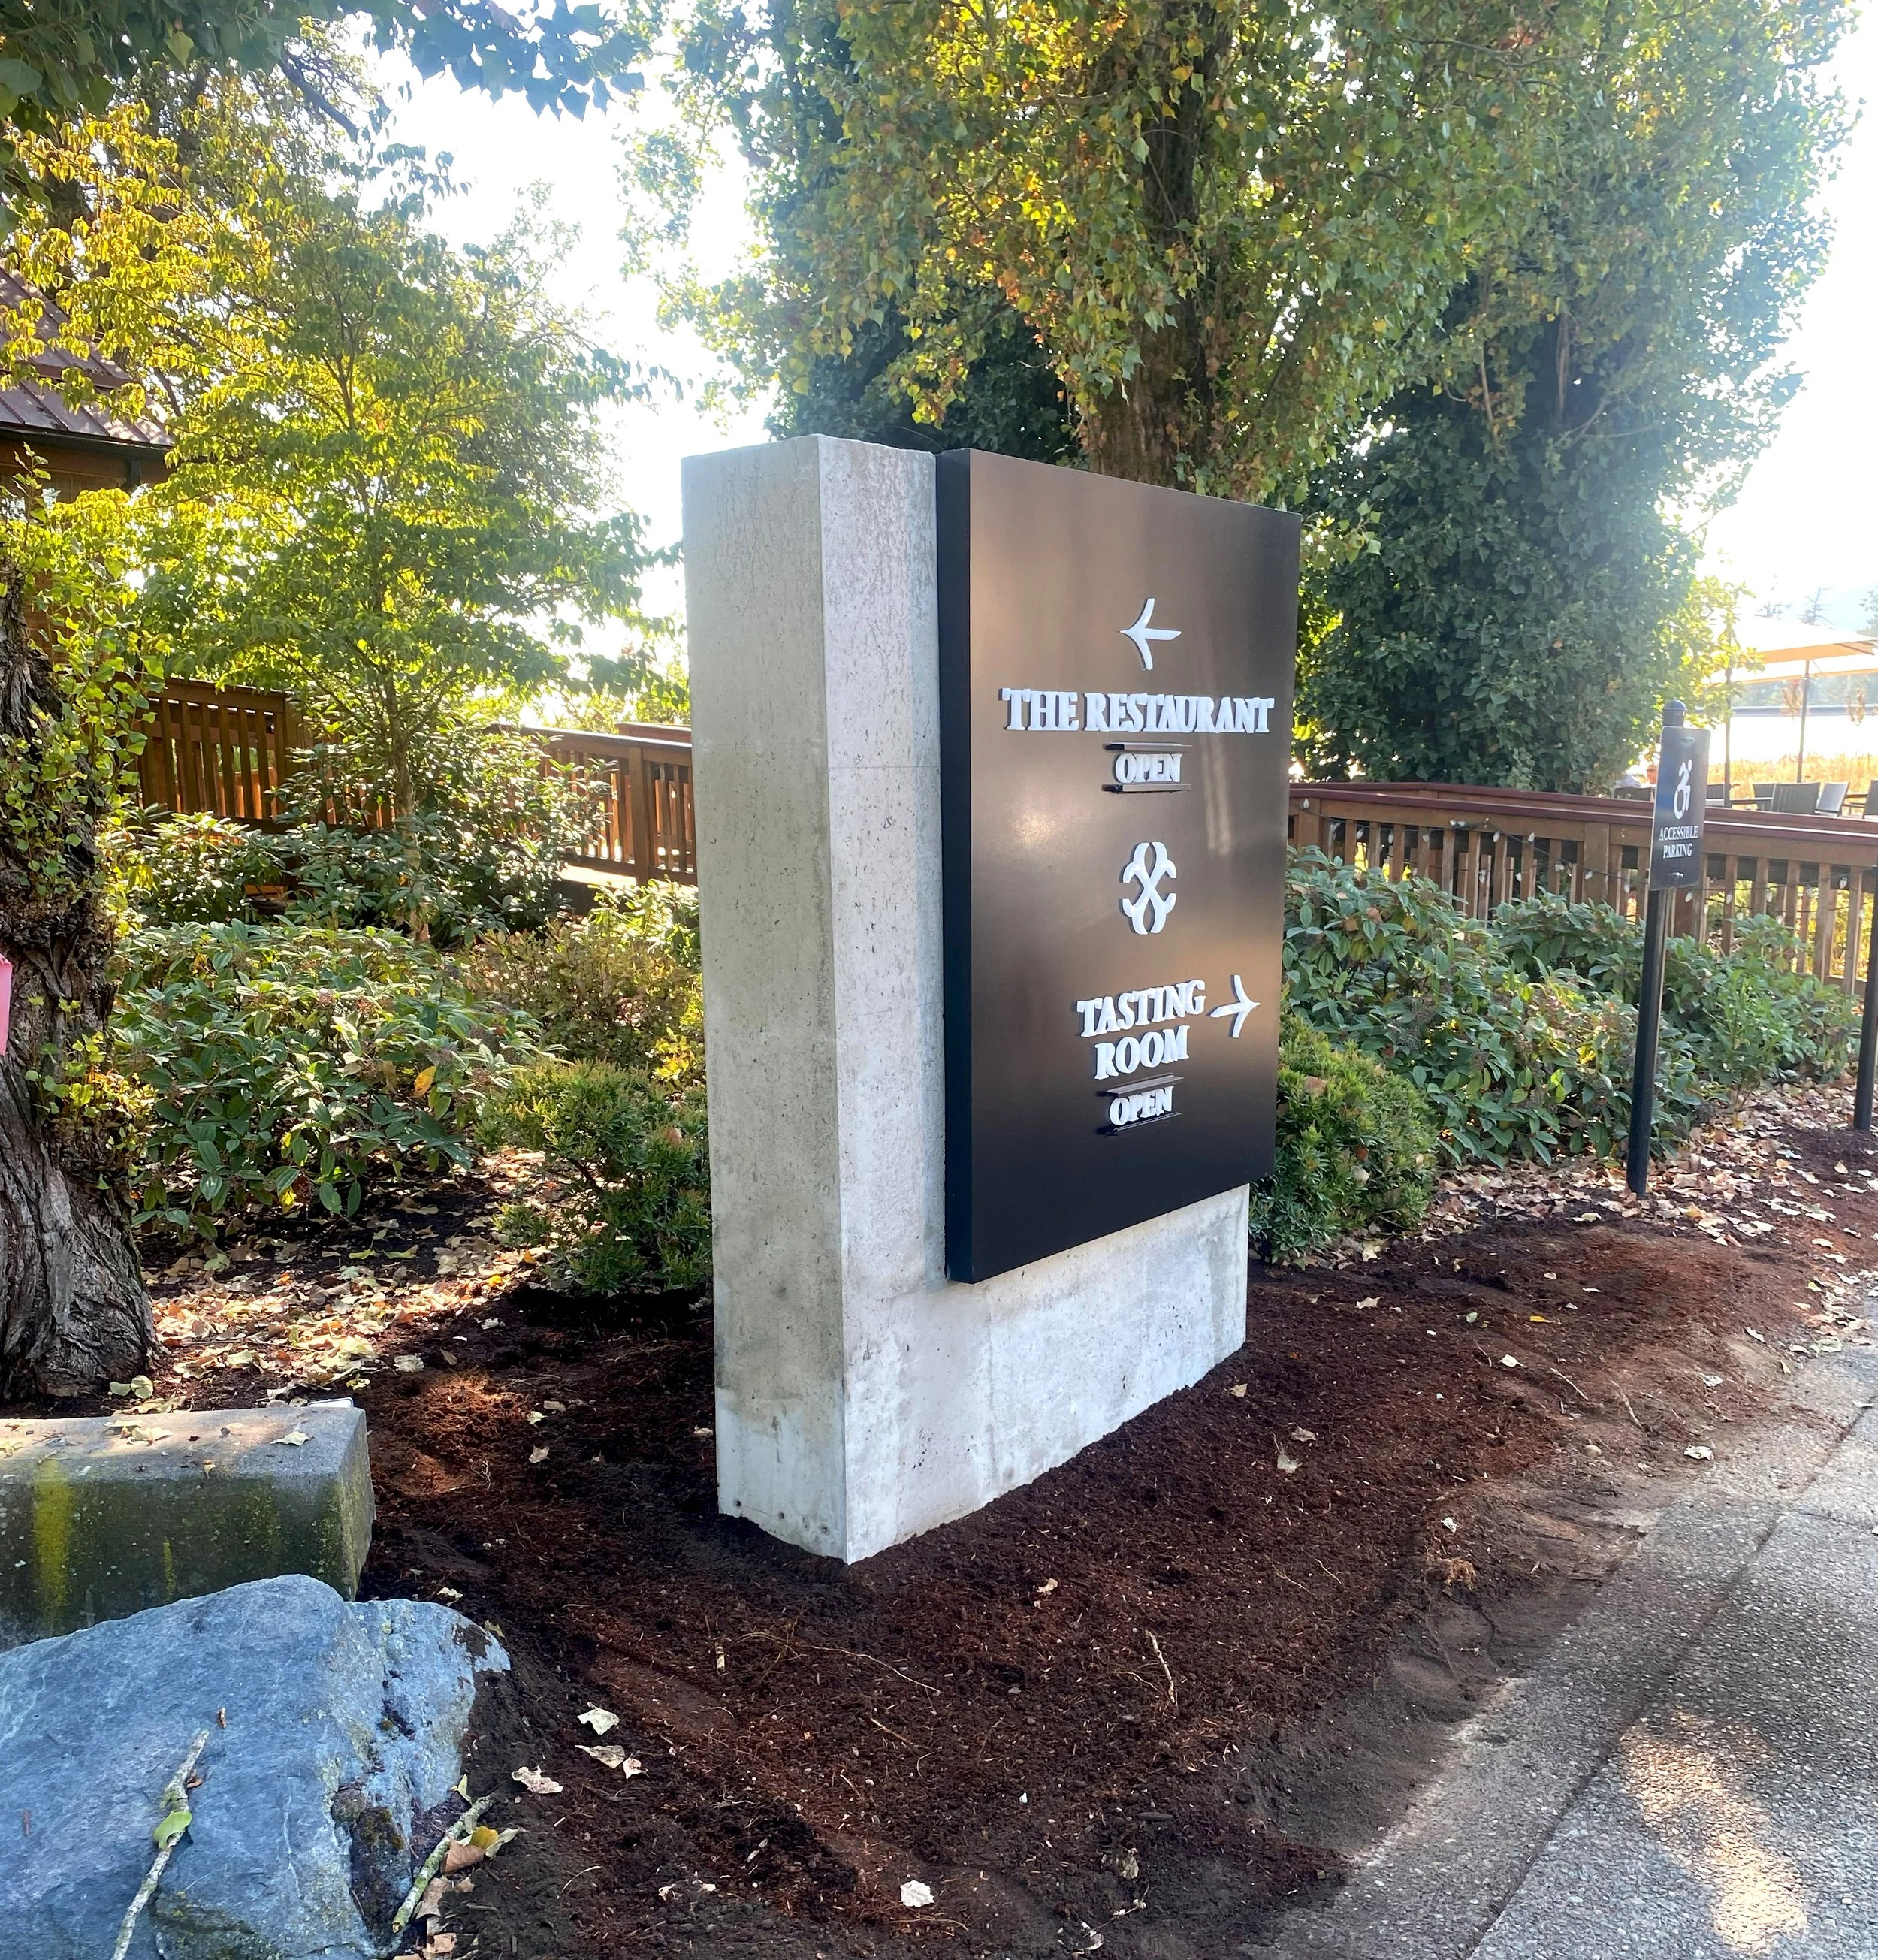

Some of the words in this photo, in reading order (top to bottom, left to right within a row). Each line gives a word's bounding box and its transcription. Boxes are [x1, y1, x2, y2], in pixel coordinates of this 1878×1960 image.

[1000, 687, 1079, 731] THE
[1083, 693, 1275, 734] RESTAURANT
[1114, 753, 1182, 783] OPEN
[1659, 826, 1698, 841] ACCESSIBLE
[1662, 843, 1692, 859] PARKING
[1076, 980, 1206, 1037] TASTING
[1094, 1025, 1190, 1080] ROOM
[1109, 1086, 1174, 1125] OPEN
